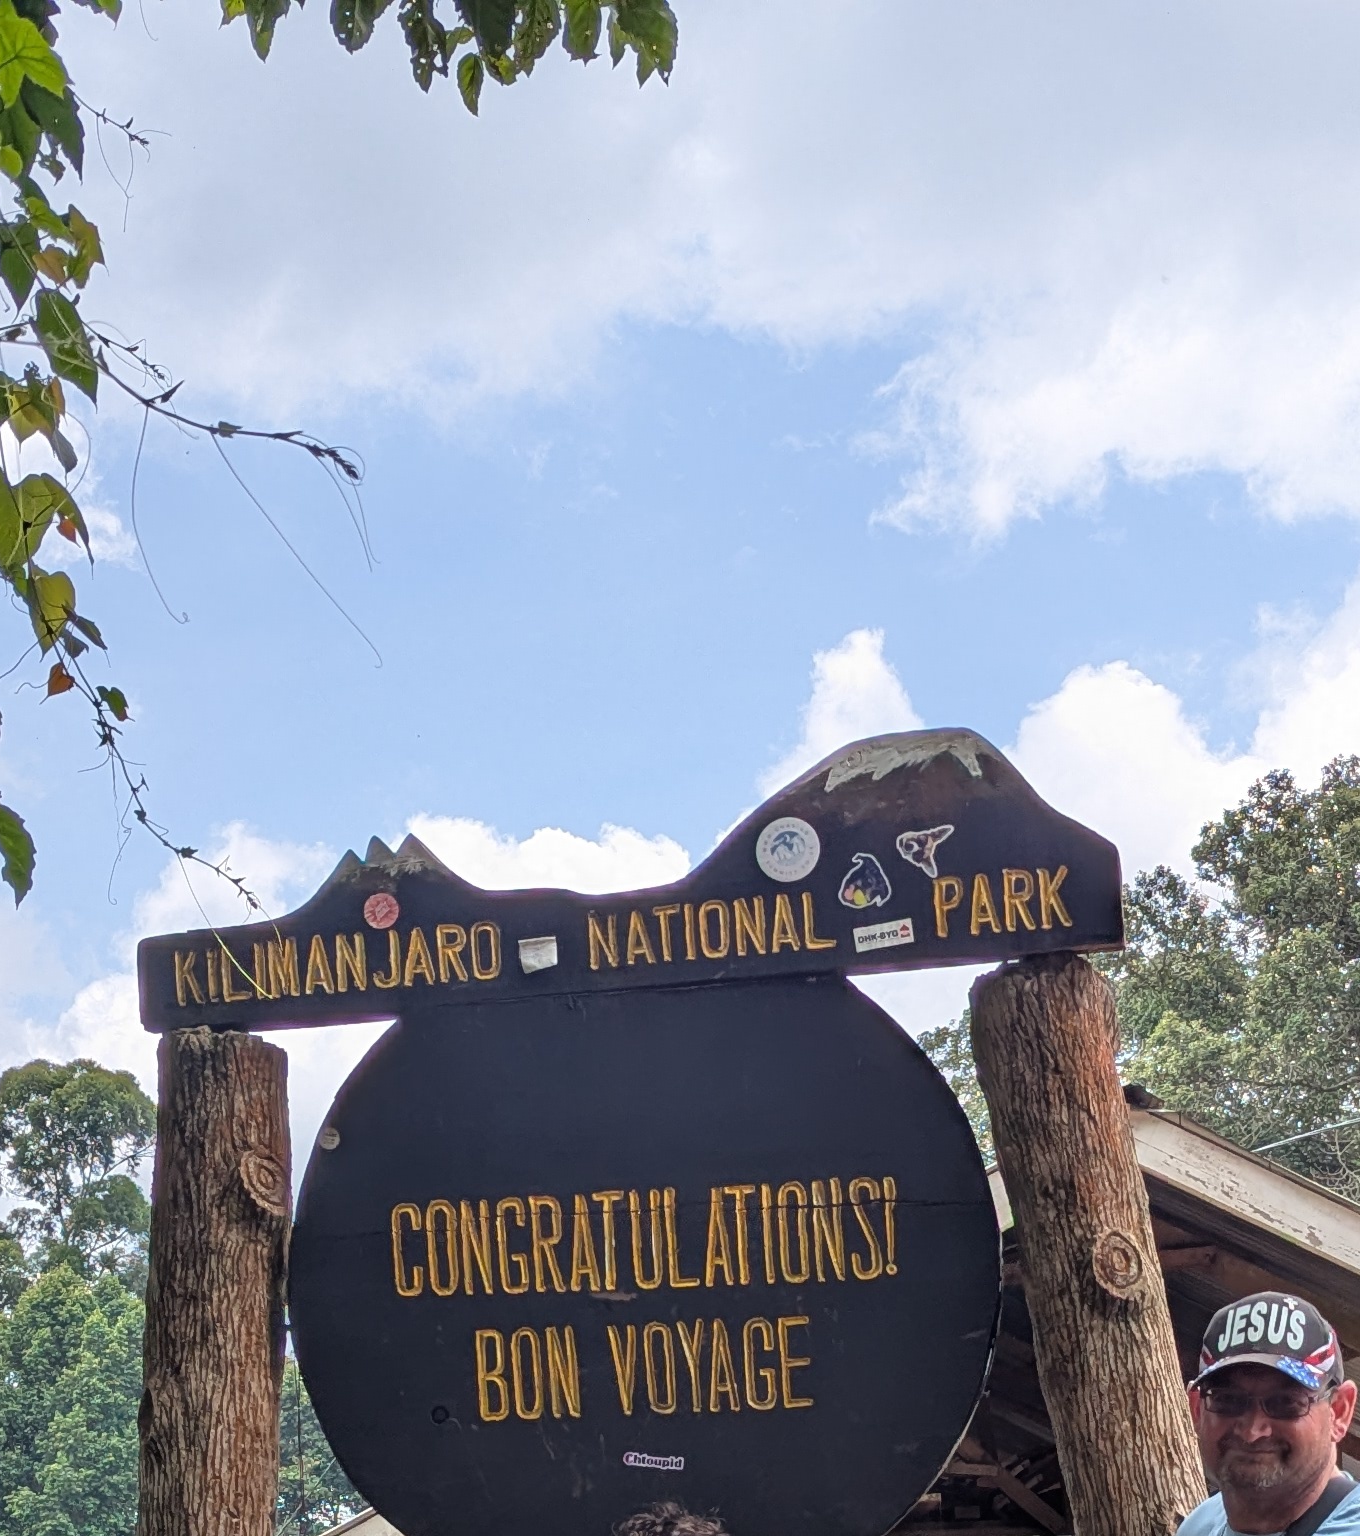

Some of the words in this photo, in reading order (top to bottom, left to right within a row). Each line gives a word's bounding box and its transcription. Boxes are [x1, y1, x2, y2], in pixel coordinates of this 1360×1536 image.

[174, 921, 503, 1007] KILIMANJARO
[589, 891, 837, 970] NATIONAL
[933, 865, 1073, 938] PARK
[391, 1176, 899, 1298] CONGRATULATIONS!
[474, 1325, 582, 1422] BON
[606, 1316, 814, 1416] VOYAGE
[1217, 1301, 1306, 1352] JESUS
